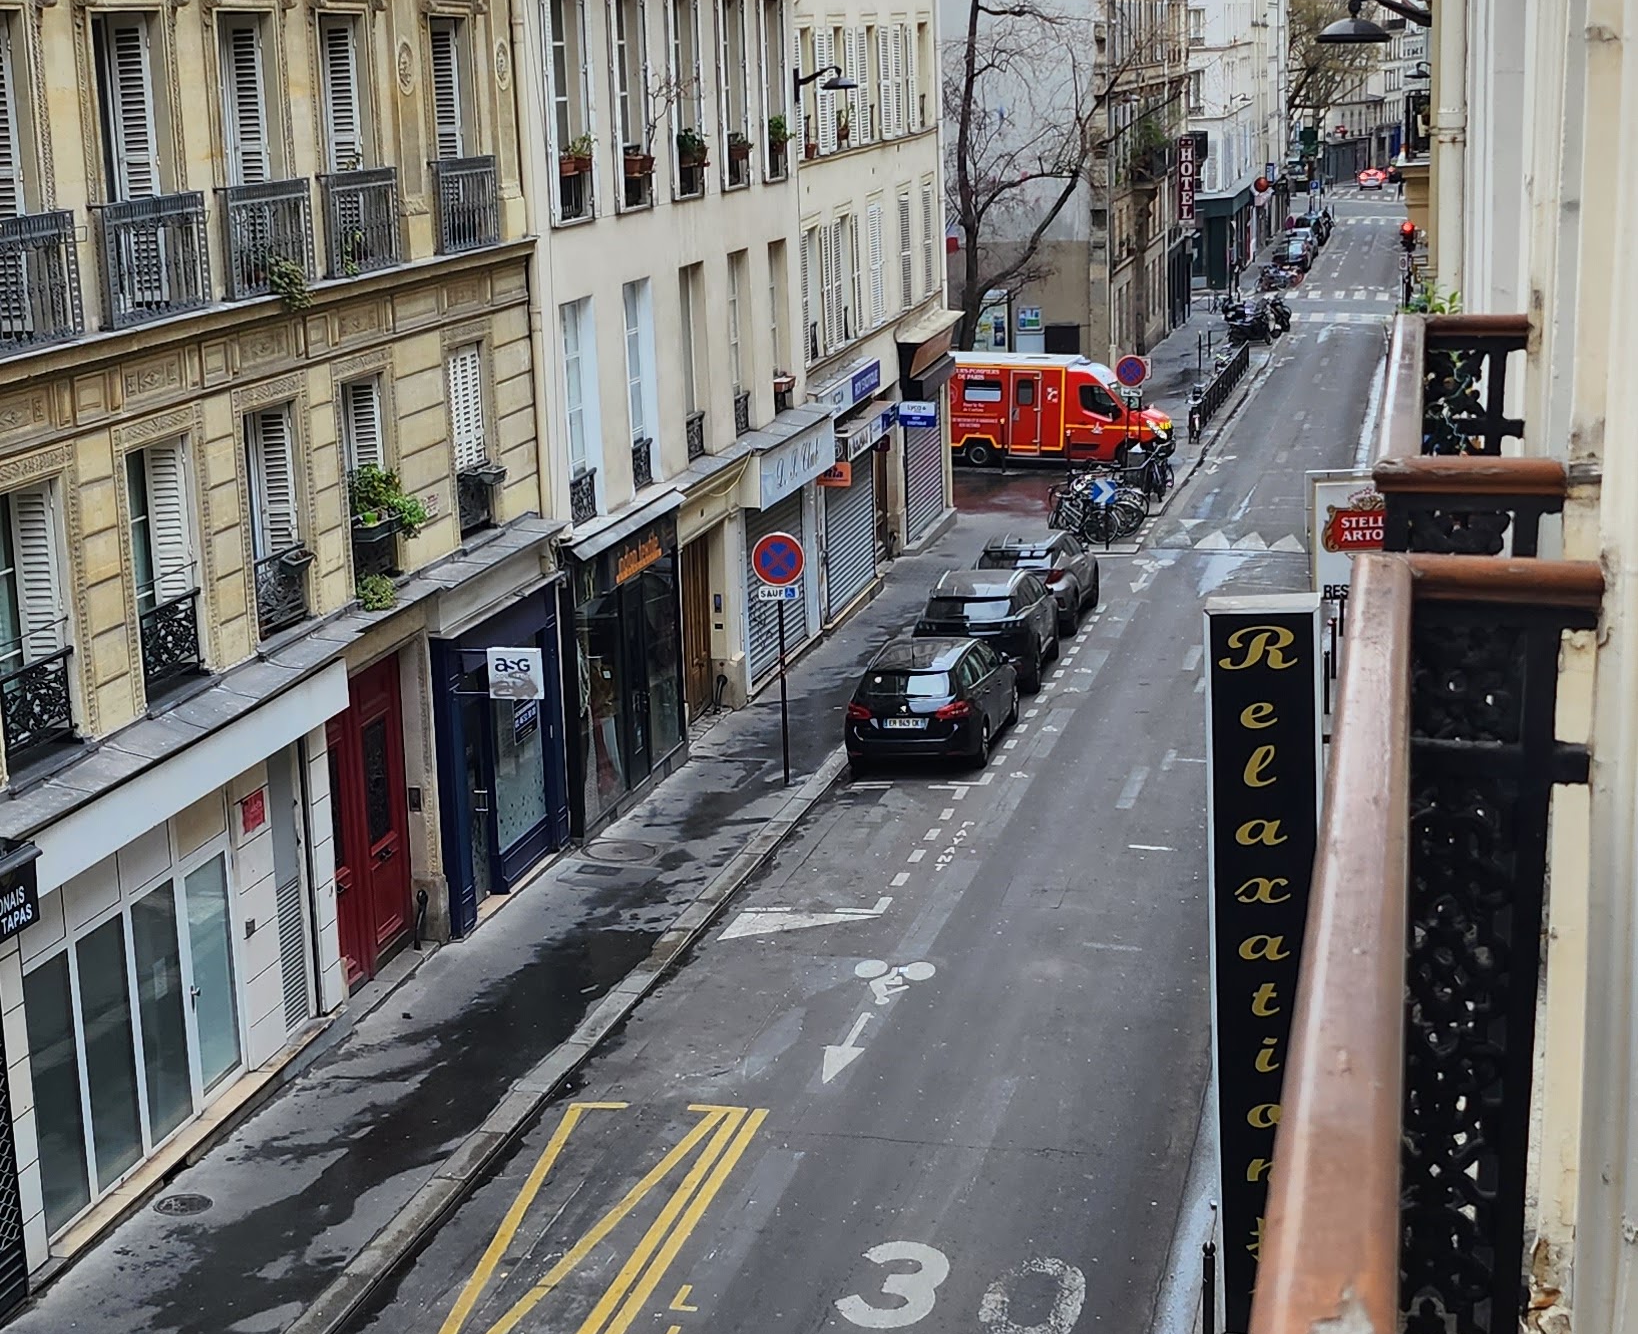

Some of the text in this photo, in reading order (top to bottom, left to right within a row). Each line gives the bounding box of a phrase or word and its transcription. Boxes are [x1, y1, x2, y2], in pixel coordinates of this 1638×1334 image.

[1180, 147, 1193, 219] HOTEL
[760, 589, 784, 598] SAUF
[1, 903, 33, 935] TAPAS
